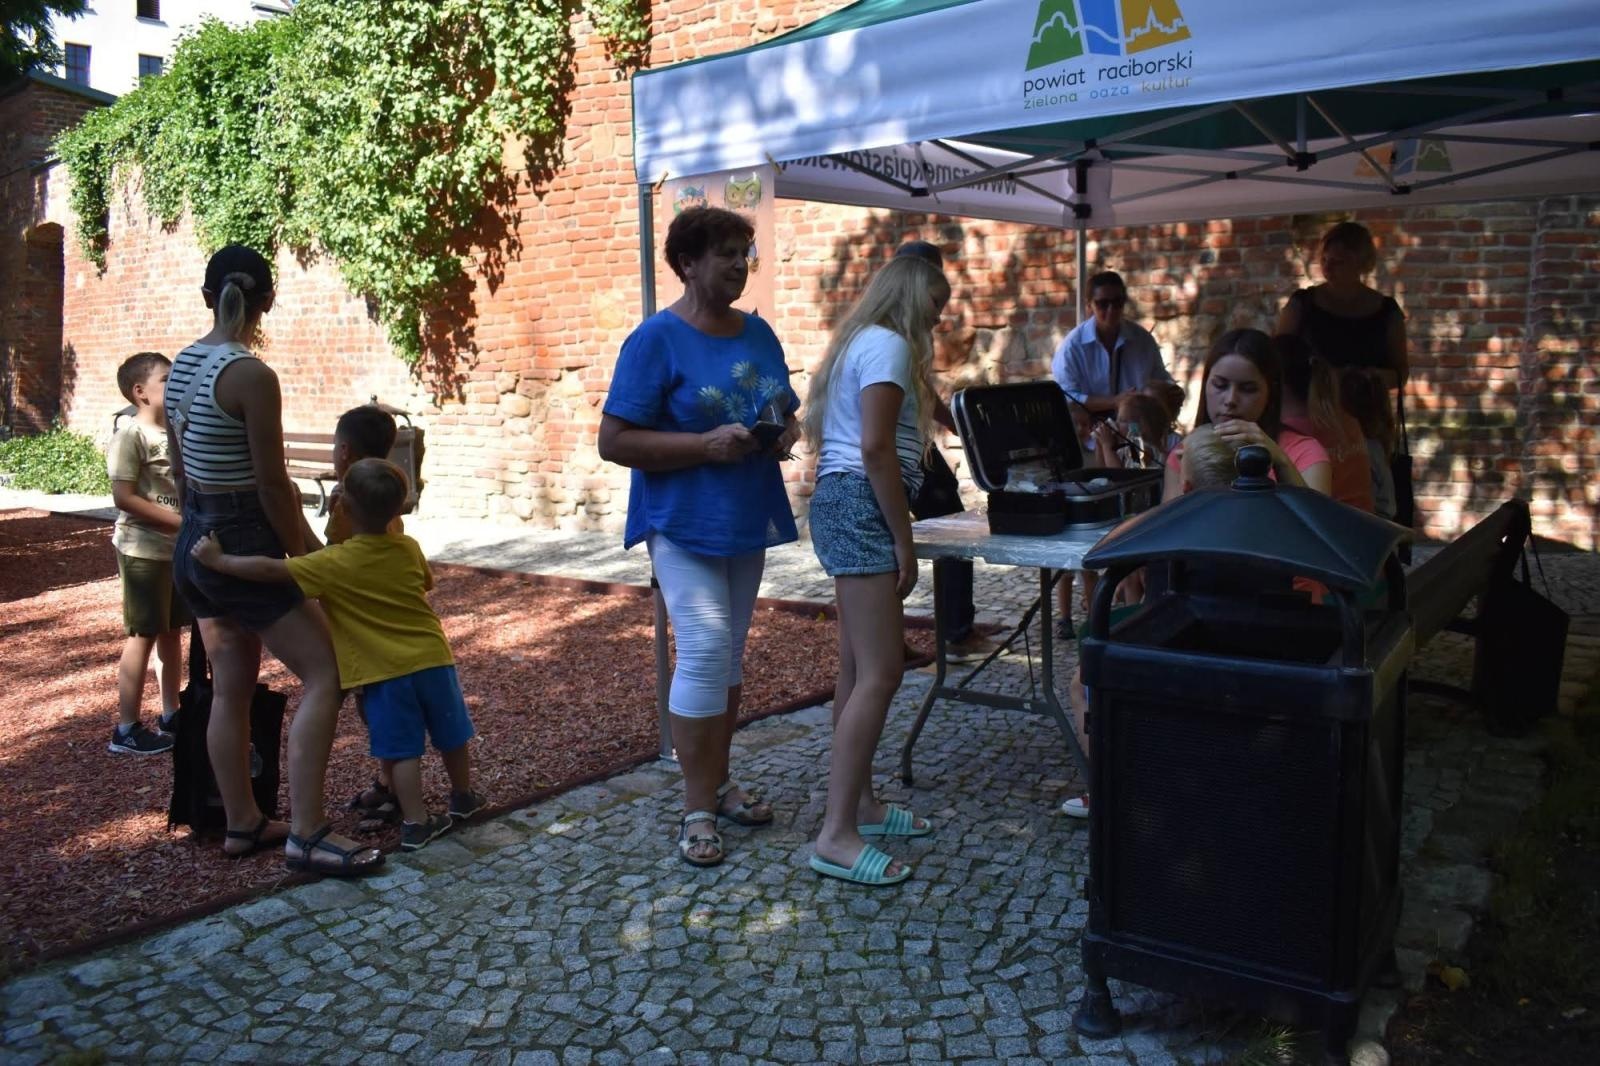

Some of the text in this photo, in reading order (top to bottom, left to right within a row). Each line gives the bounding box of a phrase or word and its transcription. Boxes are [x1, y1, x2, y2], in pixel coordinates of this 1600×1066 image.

[1023, 50, 1193, 97] powiat raciborski
[1023, 76, 1192, 110] zielona oaza kultur
